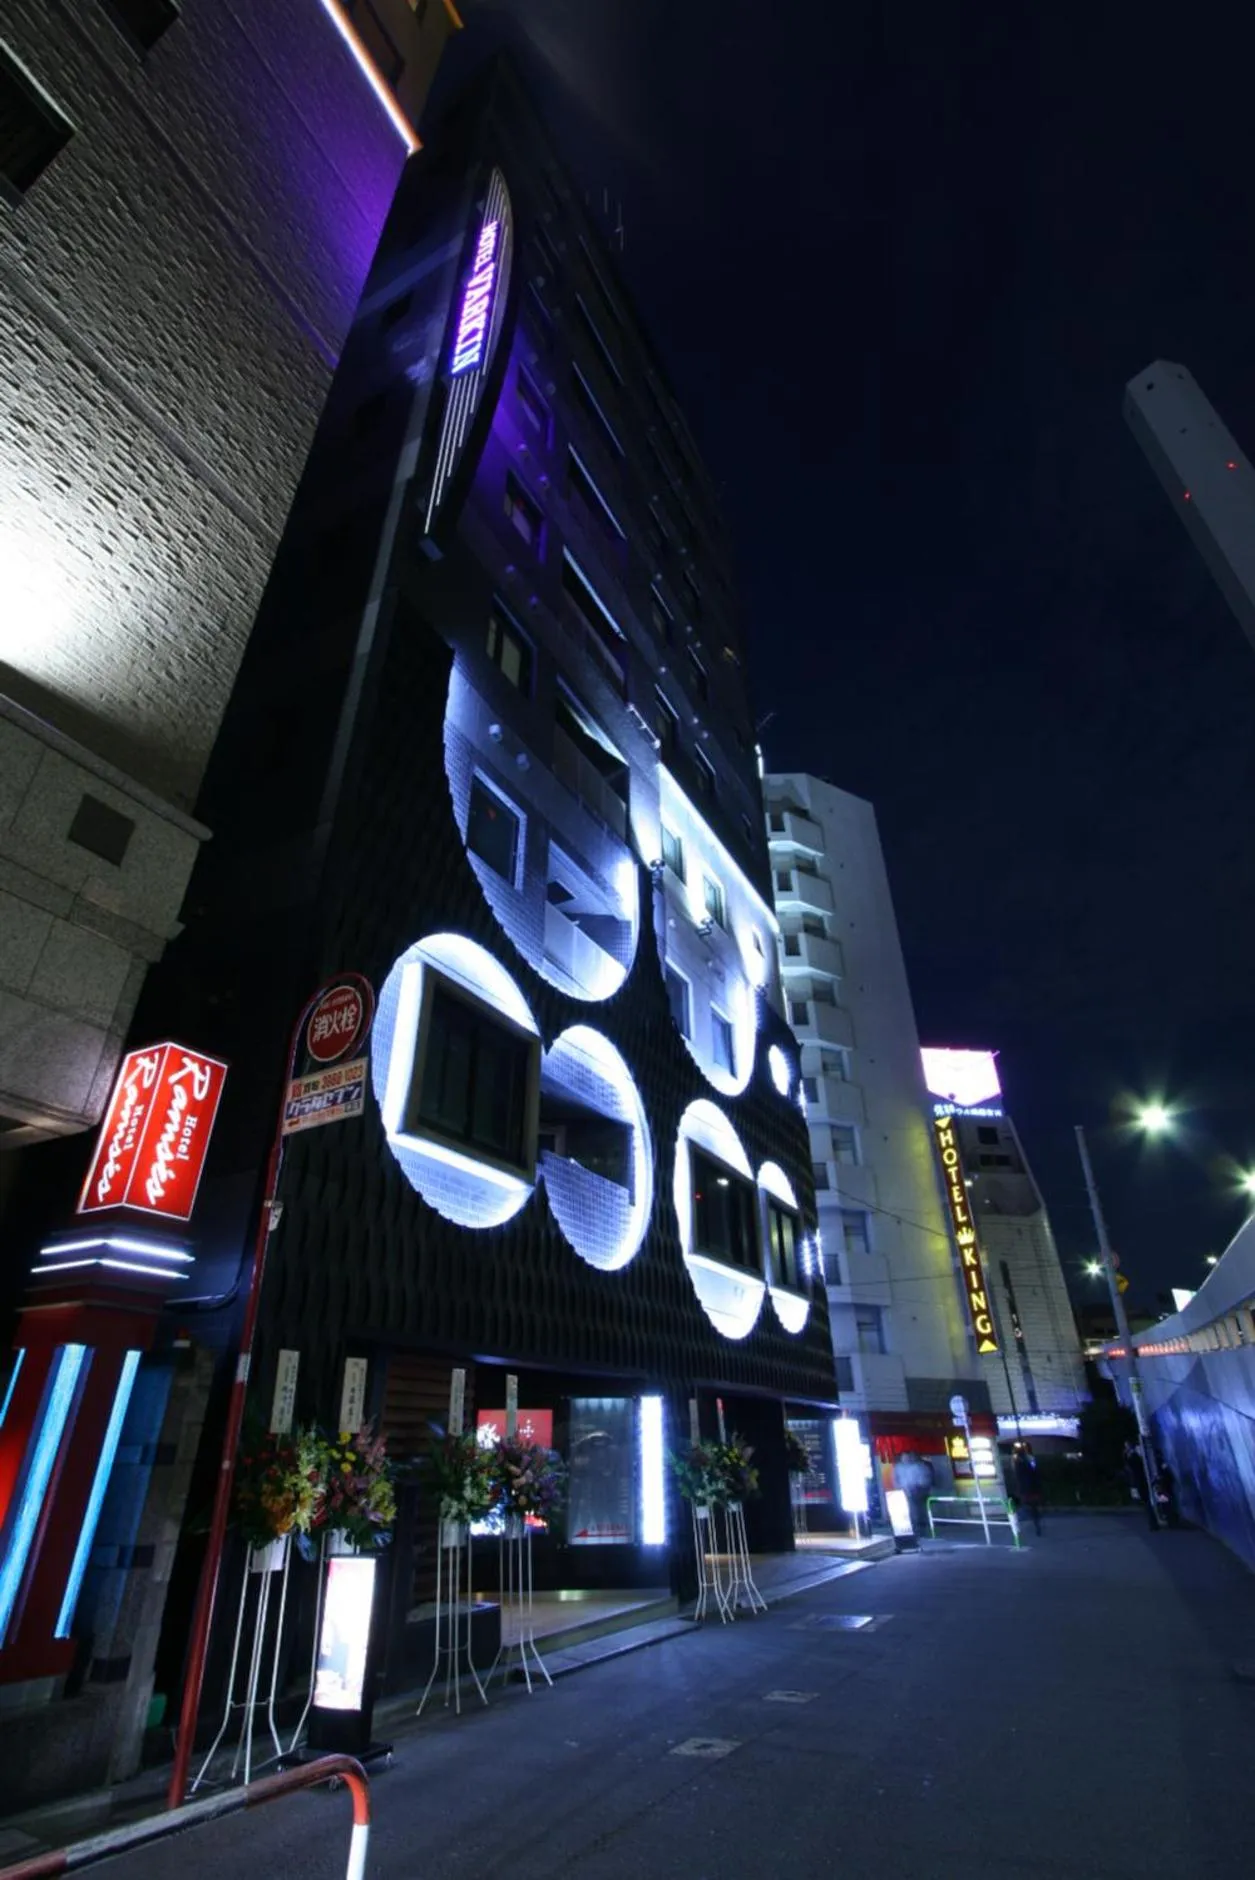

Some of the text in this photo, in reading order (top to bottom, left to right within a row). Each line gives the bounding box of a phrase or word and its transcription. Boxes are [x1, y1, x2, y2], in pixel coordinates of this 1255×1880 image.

[473, 220, 498, 273] HOTEL
[311, 1003, 358, 1042] 消火栓
[123, 1104, 145, 1150] Hotel
[175, 1114, 198, 1160] Hotel
[938, 1129, 993, 1335] HOTEL KING
